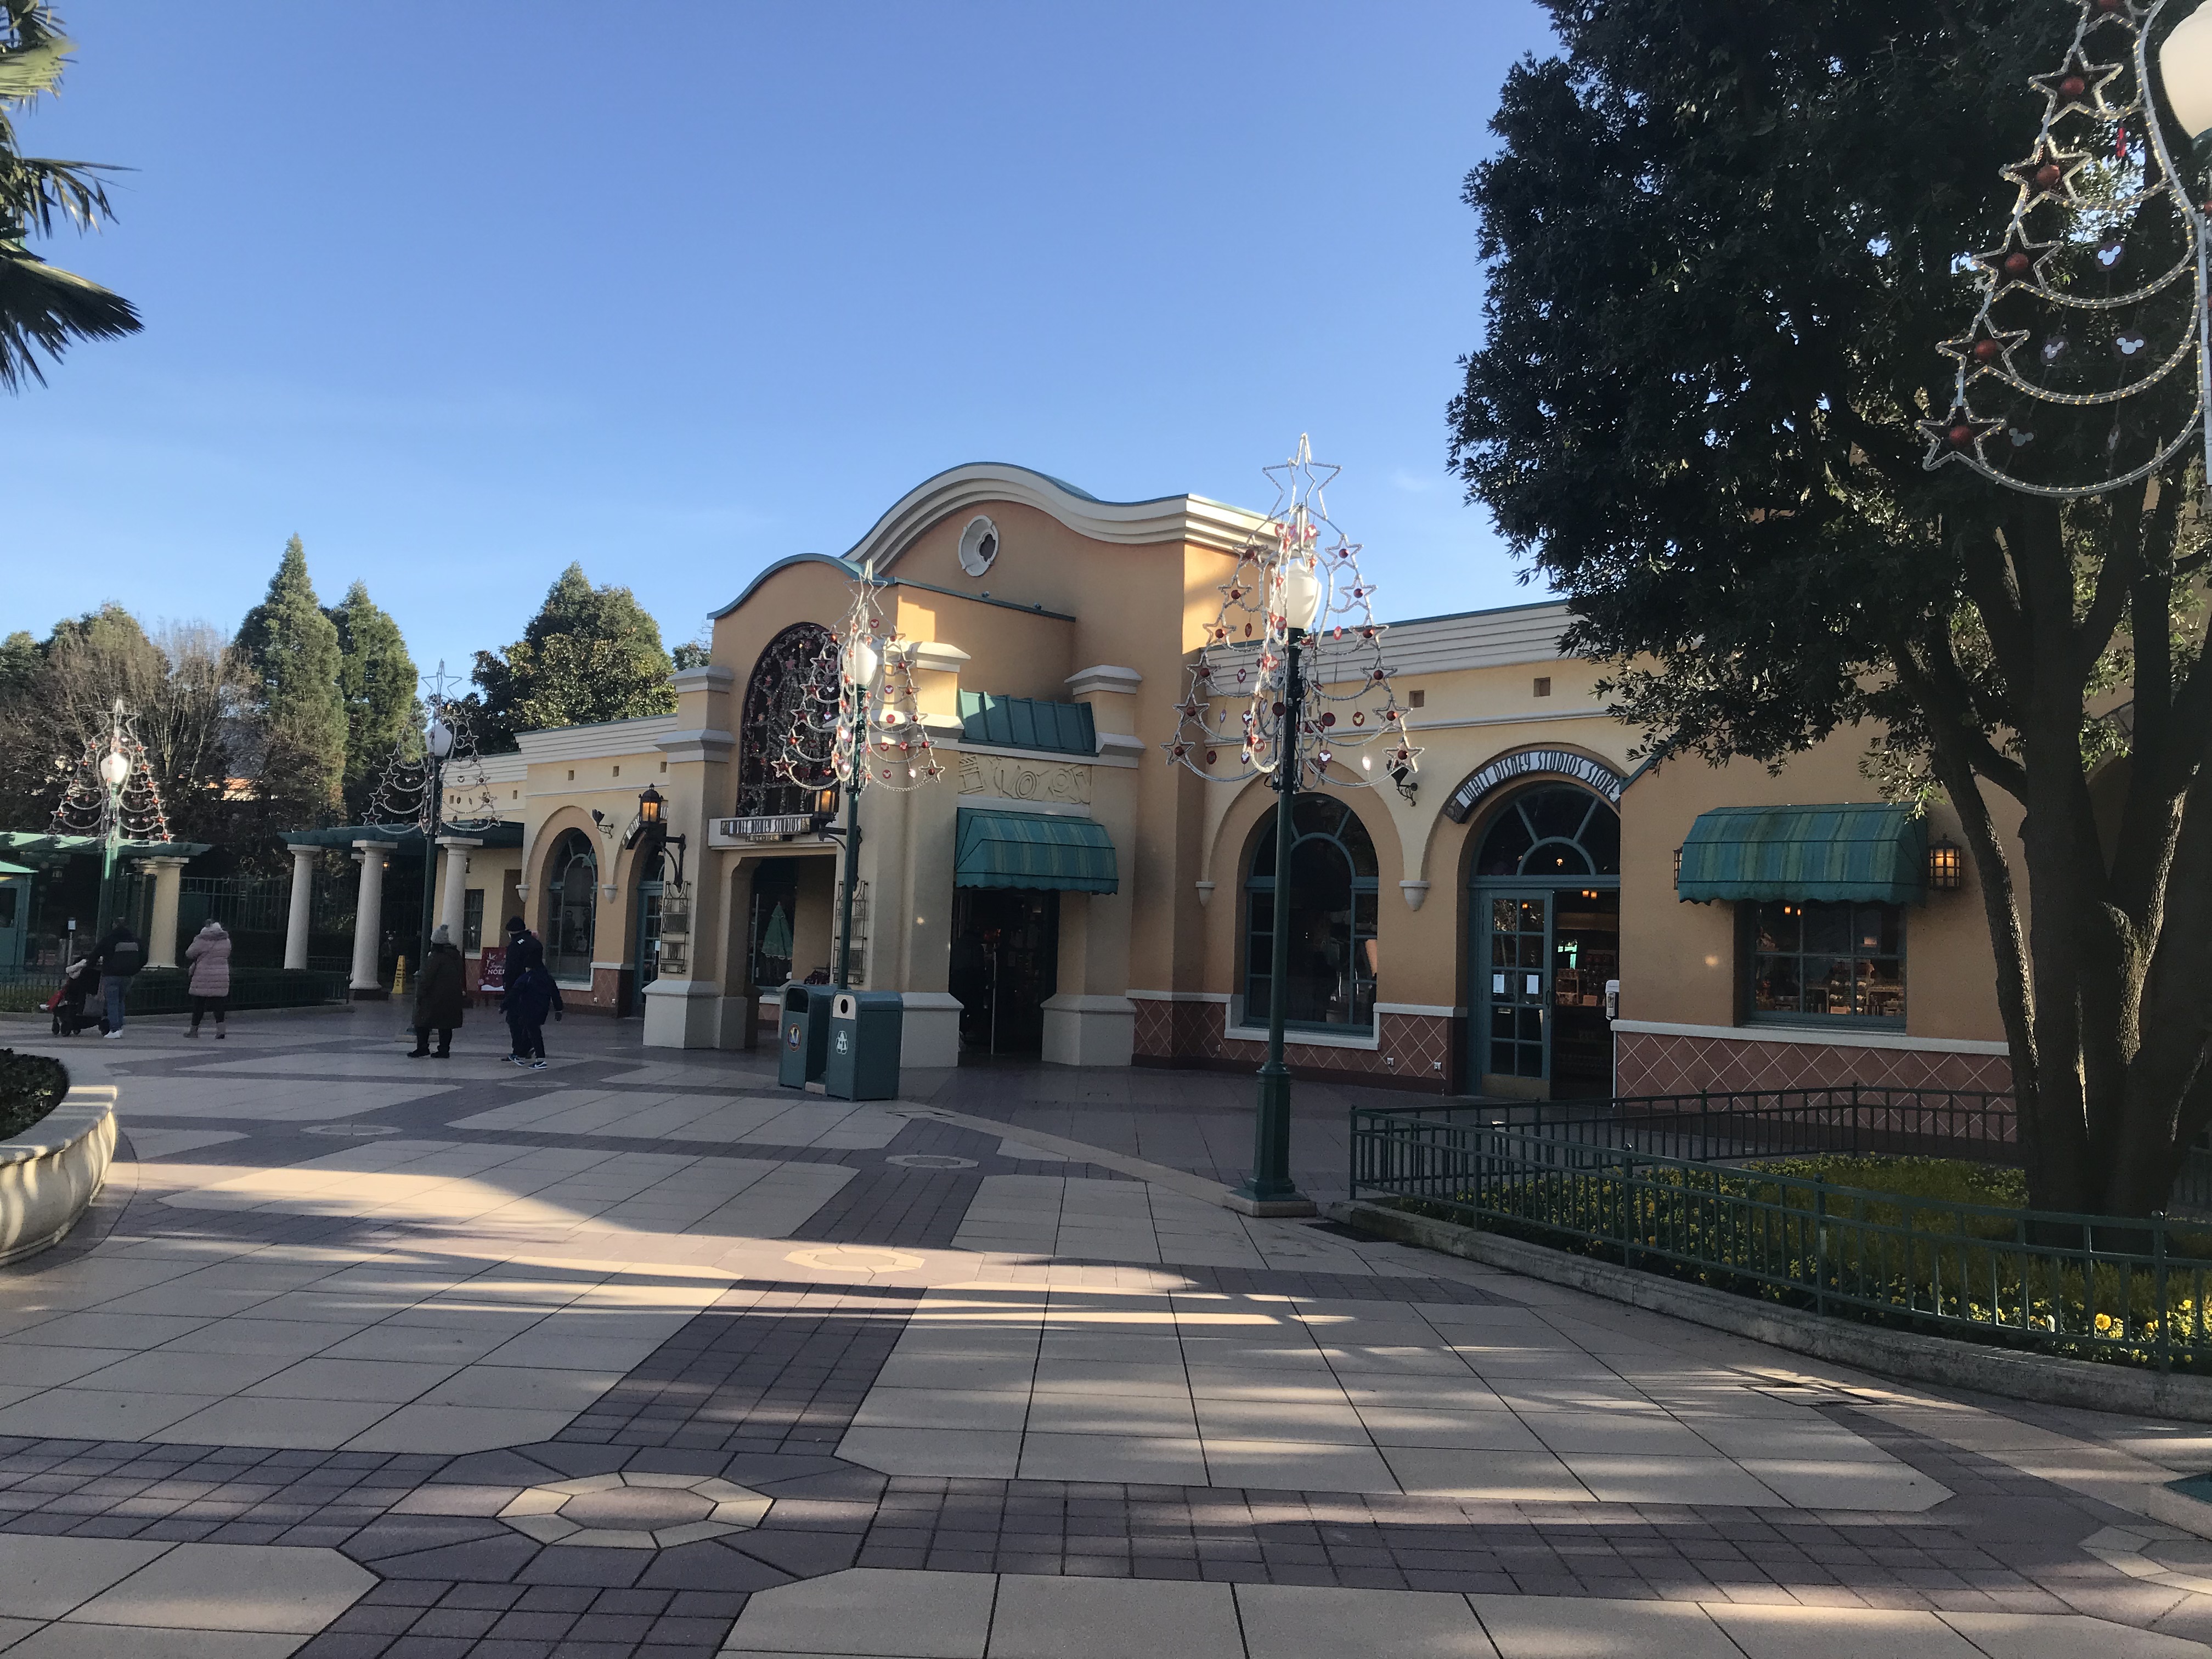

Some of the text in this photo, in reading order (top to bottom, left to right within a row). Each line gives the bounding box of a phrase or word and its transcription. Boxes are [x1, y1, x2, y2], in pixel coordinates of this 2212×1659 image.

[1462, 751, 1619, 802] WALT DISNEY STUDIOS STORE
